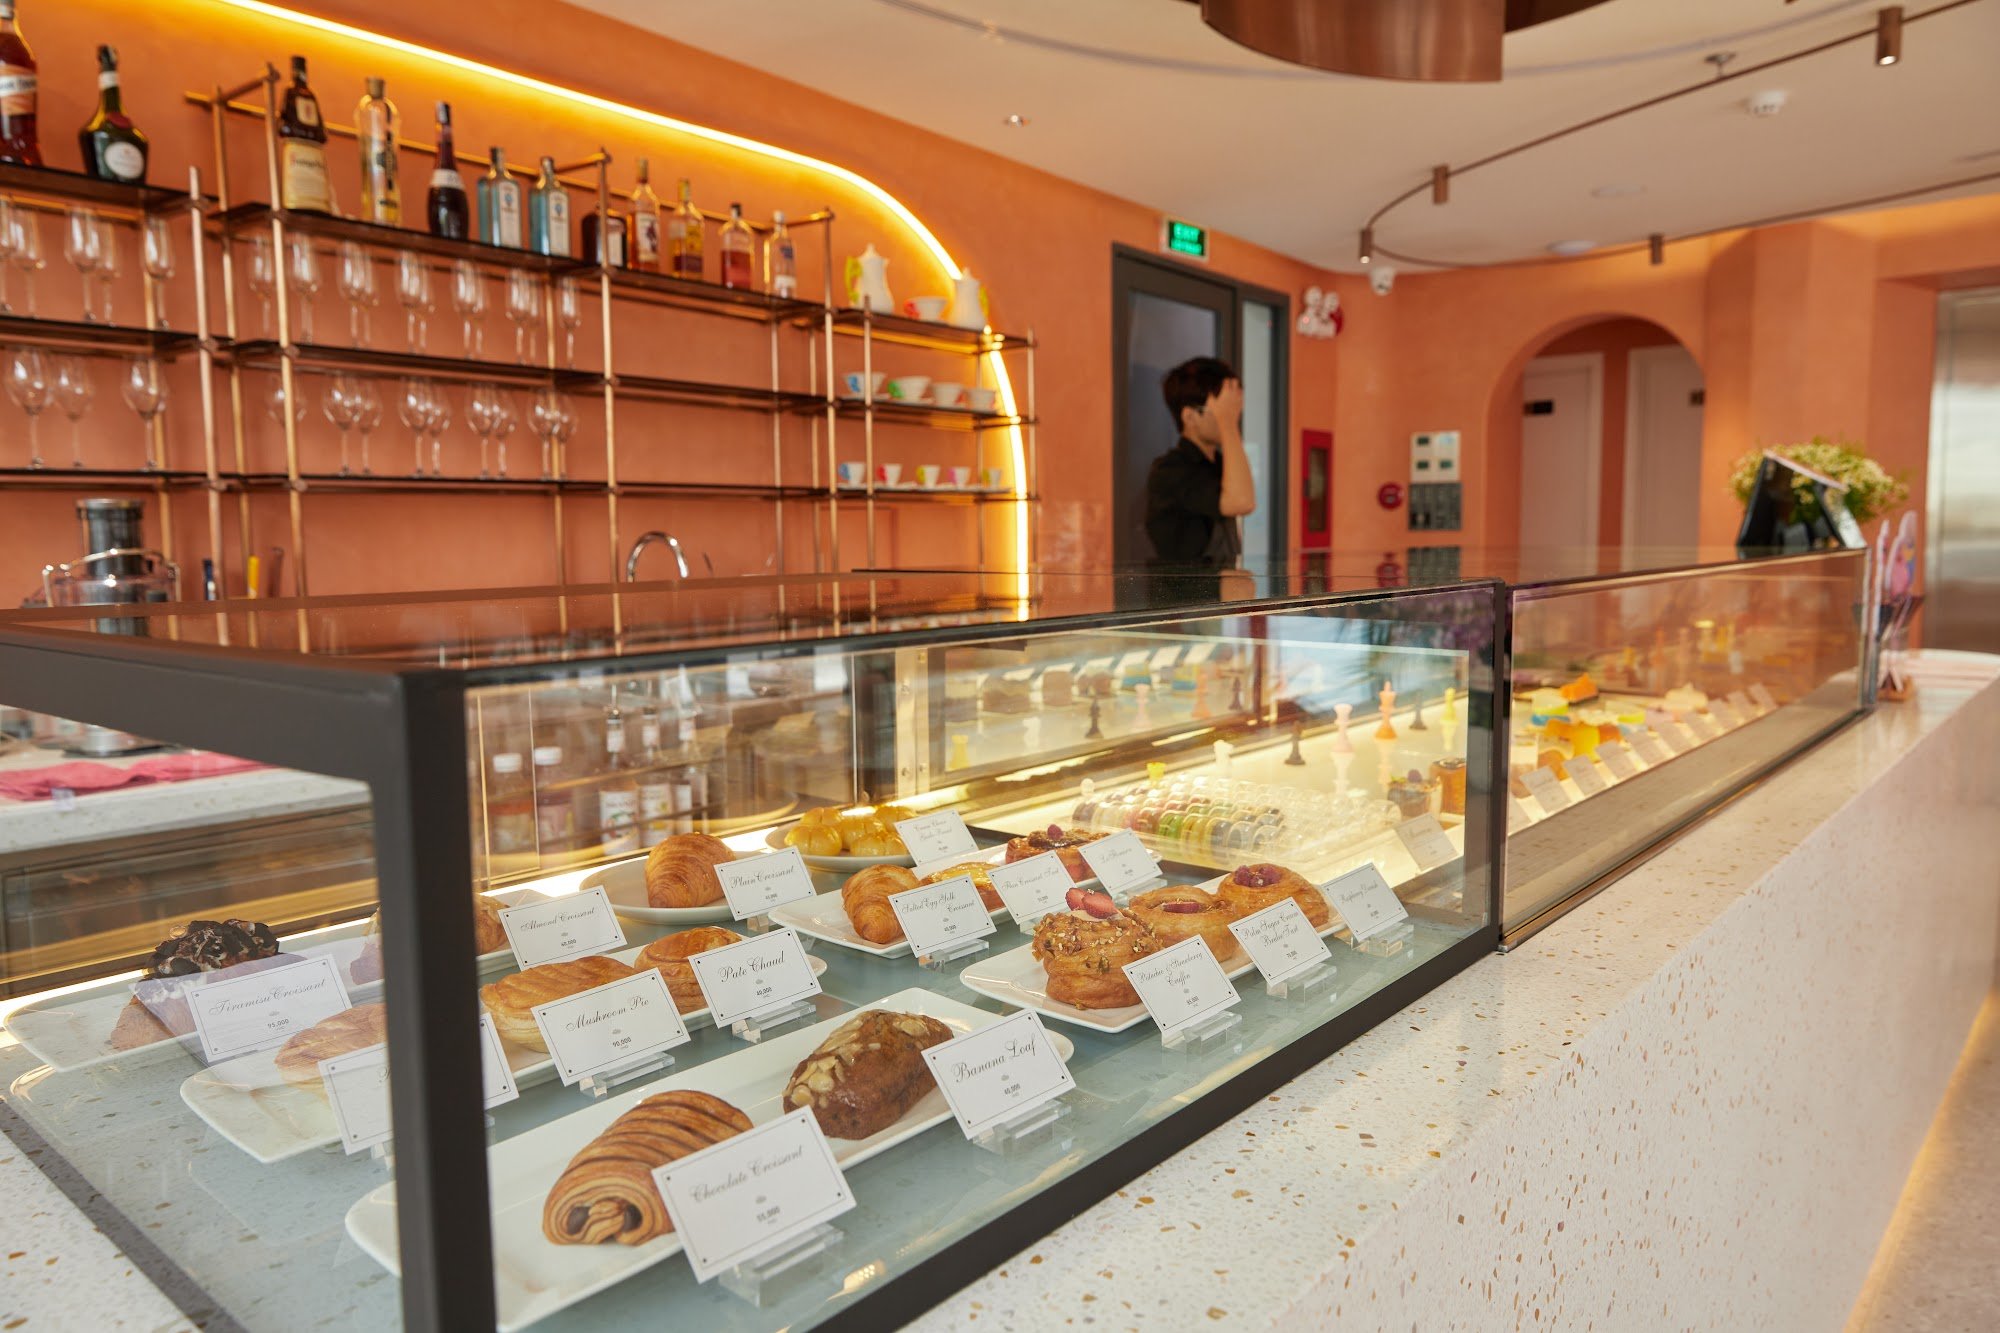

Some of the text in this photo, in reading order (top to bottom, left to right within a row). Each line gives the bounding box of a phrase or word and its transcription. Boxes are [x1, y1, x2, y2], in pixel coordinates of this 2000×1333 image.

[729, 864, 794, 889] Plain Croissant
[520, 906, 595, 932] Almond Croissant
[901, 901, 924, 914] Salted
[922, 897, 938, 909] Egg
[946, 899, 975, 913] Croissant
[1241, 927, 1261, 941] Palm
[718, 950, 786, 983] Pate Chaud
[208, 978, 326, 1016] Tiramisu Croissant
[565, 994, 650, 1032] Mushroom Pie
[950, 1032, 1037, 1083] Banana Loaf
[690, 1144, 804, 1203] Chocolate Croissant
